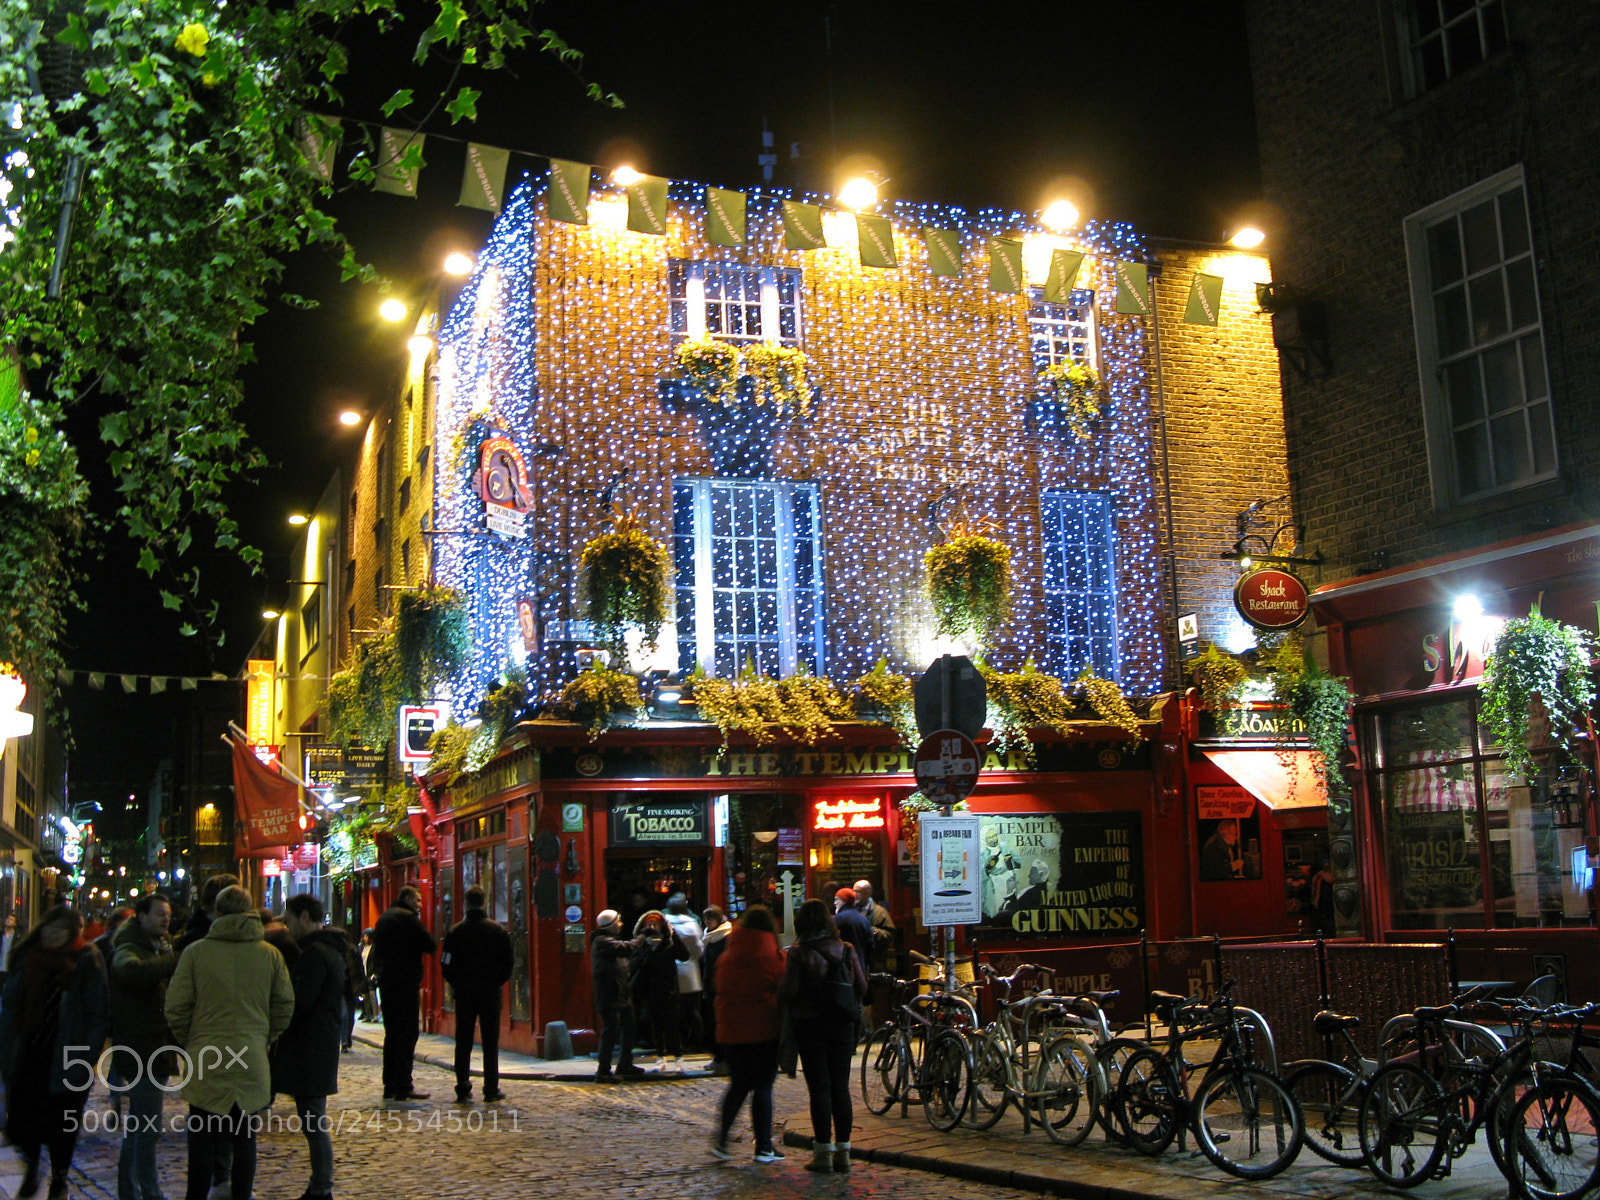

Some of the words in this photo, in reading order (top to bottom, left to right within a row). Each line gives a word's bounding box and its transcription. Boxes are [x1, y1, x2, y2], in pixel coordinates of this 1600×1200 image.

[1249, 598, 1300, 610] Restaurant
[701, 753, 779, 776] THE
[796, 751, 913, 775] TEMPL
[980, 750, 1028, 772] AR
[263, 807, 284, 817] THE
[250, 812, 297, 829] TEMPLE
[995, 822, 1059, 835] TEMPLE
[262, 824, 289, 837] BAR
[1104, 829, 1129, 845] THE
[1015, 834, 1045, 848] BAR
[1074, 846, 1130, 863] EMPEROR
[1116, 864, 1130, 880] OF
[1040, 889, 1088, 907] MALTED
[1089, 881, 1136, 903] LIQUORS
[1011, 906, 1139, 933] GUINNESS
[1036, 971, 1113, 993] TEMPLE
[1187, 977, 1216, 1002] BA
